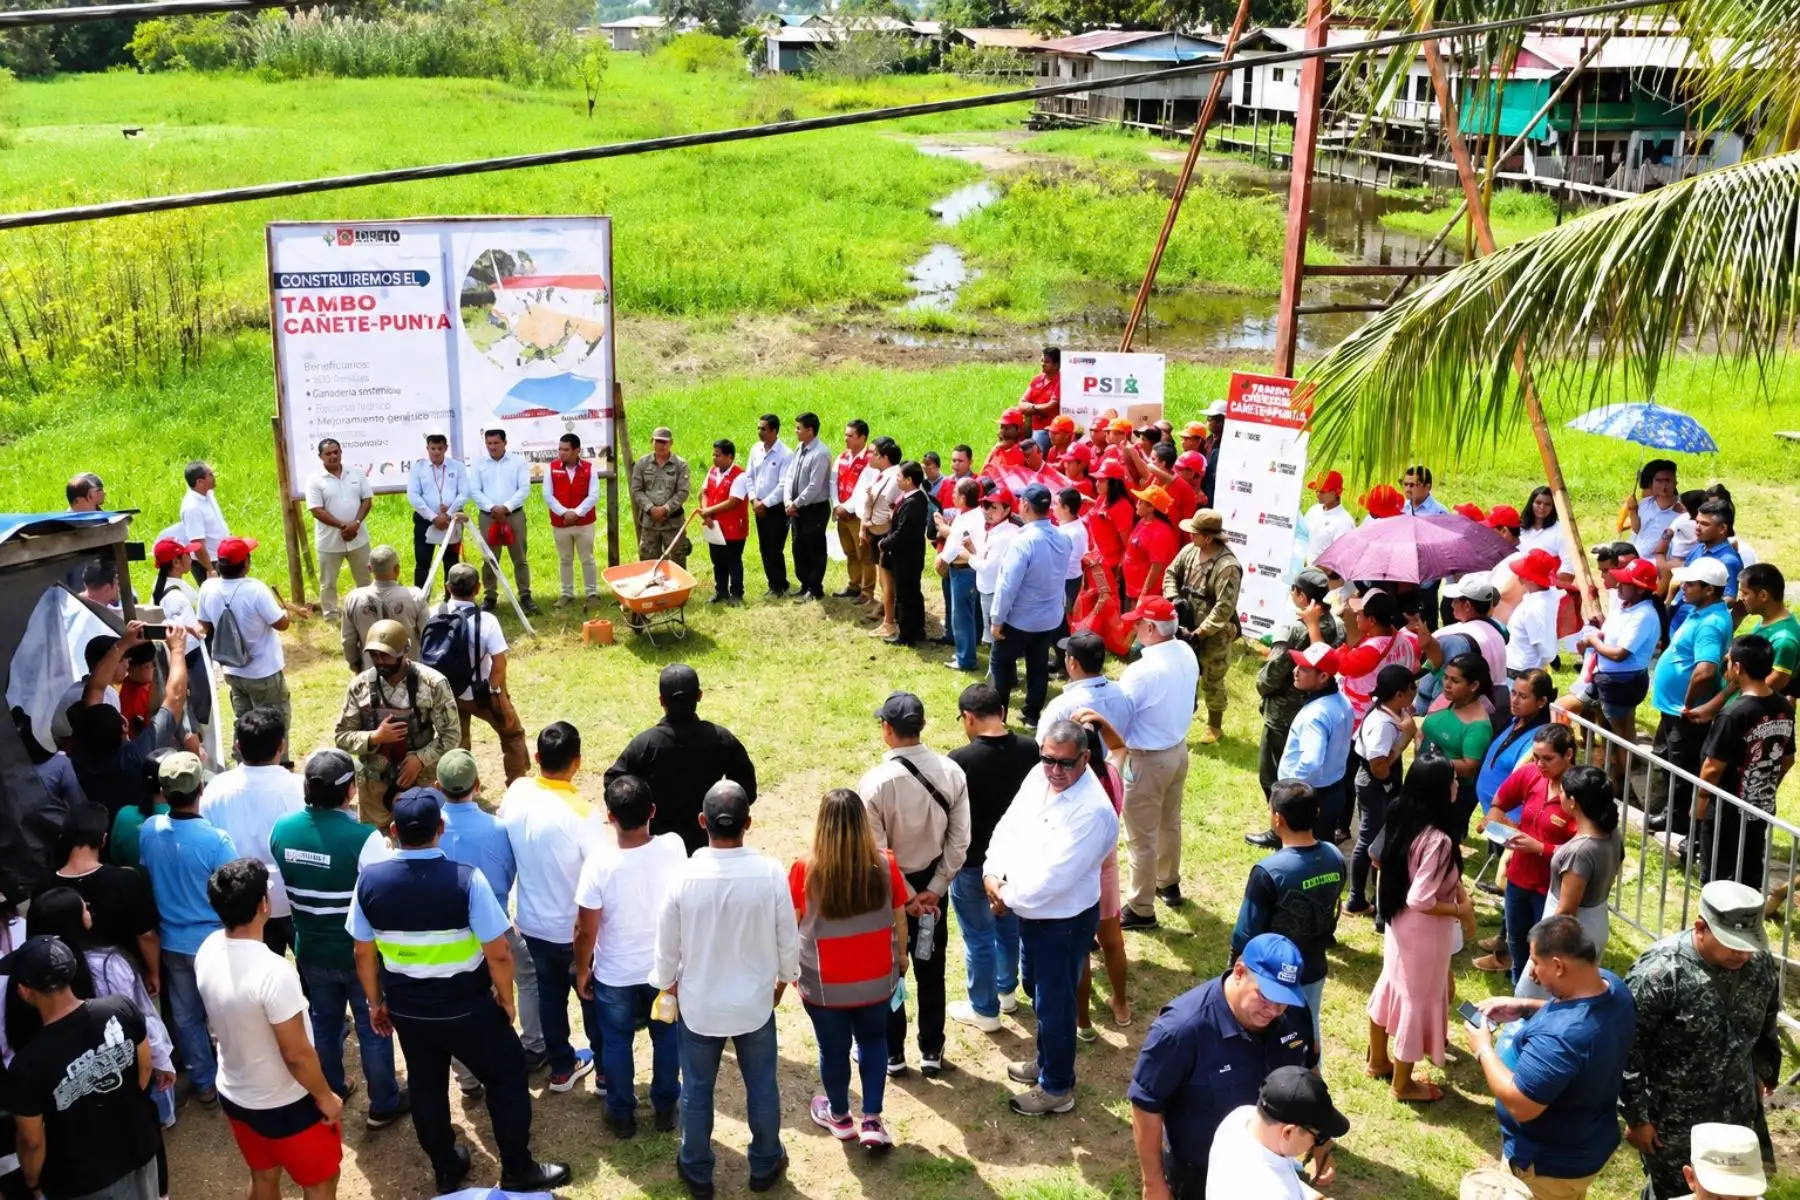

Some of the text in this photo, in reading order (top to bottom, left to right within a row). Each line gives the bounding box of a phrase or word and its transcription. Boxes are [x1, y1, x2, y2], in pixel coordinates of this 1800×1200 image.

[280, 272, 420, 287] CONSTRUIREMOS EL
[281, 294, 376, 313] TAMBO
[283, 314, 452, 334] CAÑETE-PUNTA
